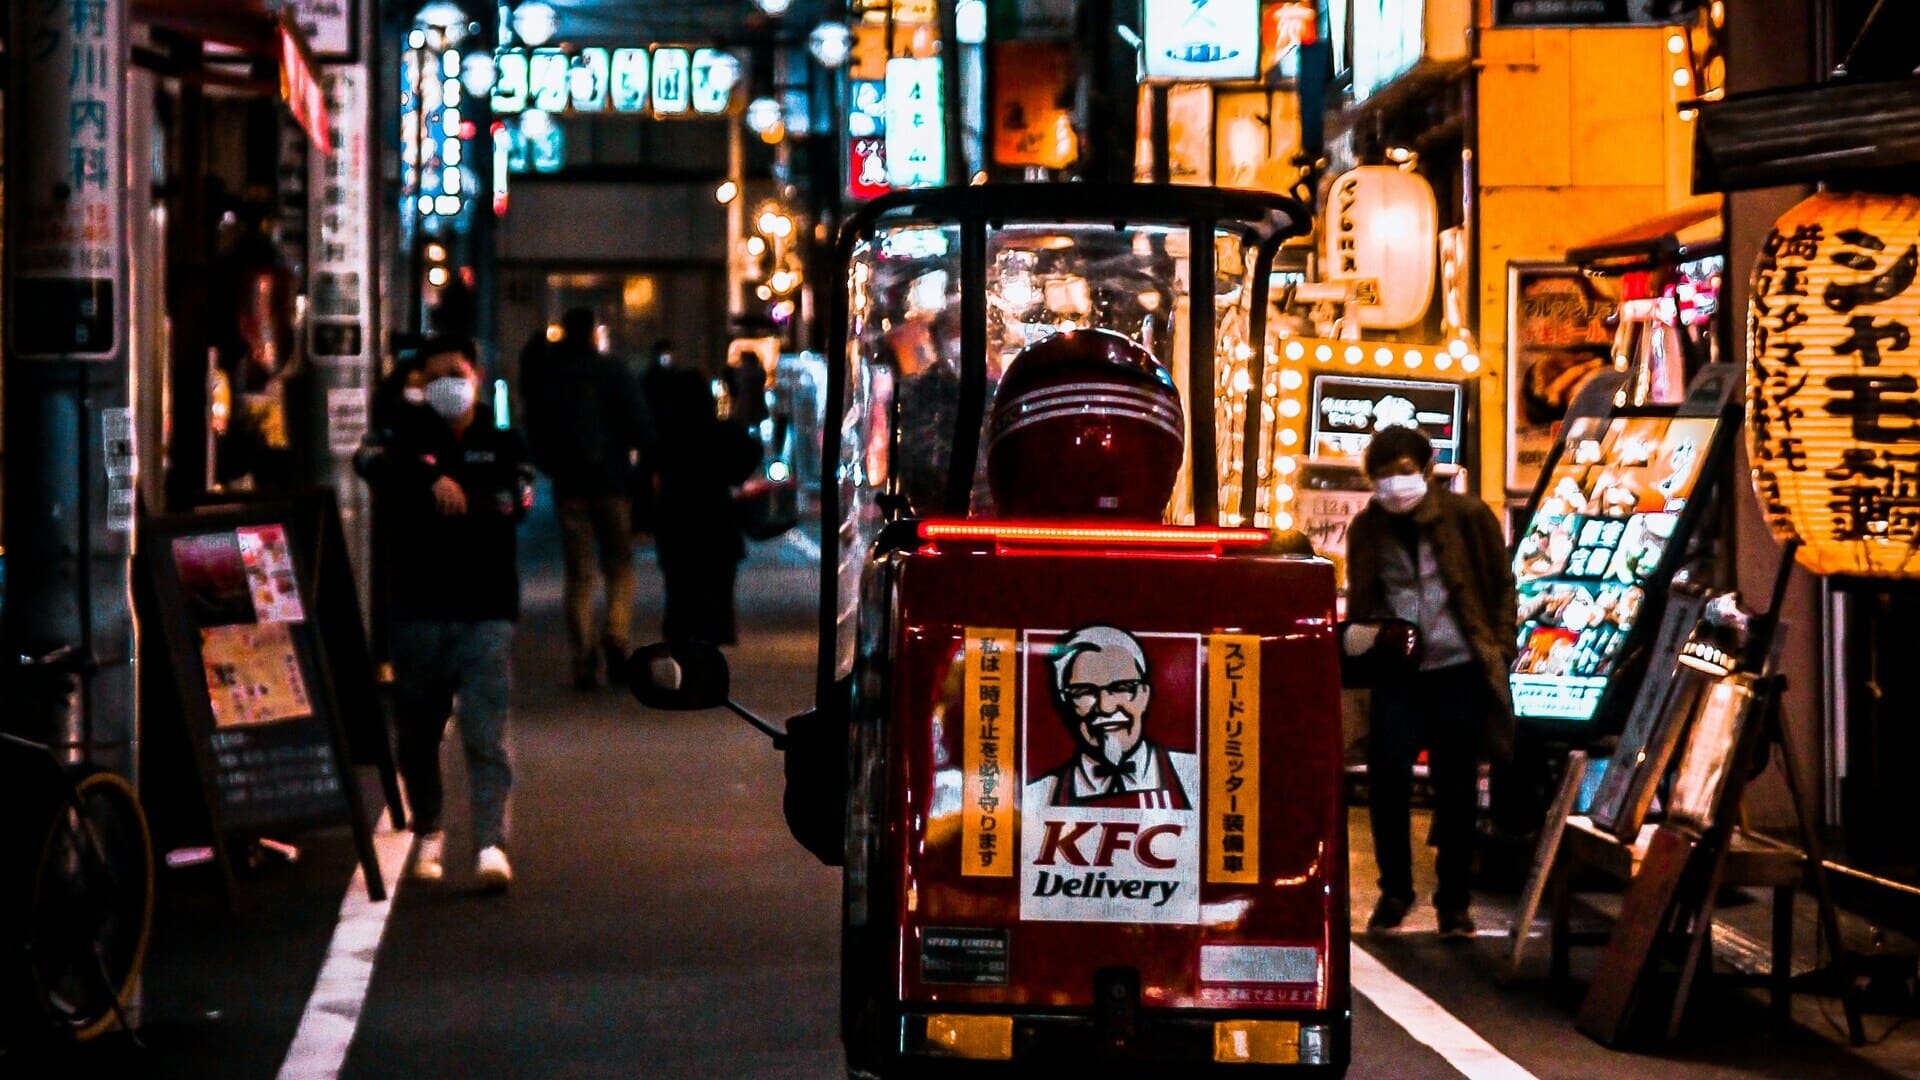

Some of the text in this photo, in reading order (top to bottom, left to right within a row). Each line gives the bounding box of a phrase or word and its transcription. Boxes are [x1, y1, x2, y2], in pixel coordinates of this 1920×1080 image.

[978, 637, 1001, 867] 私は一時停止を必ず守ります
[1222, 643, 1245, 873] スピードリミッター装備車
[1032, 871, 1180, 907] Delivery
[1033, 821, 1183, 869] KFC
